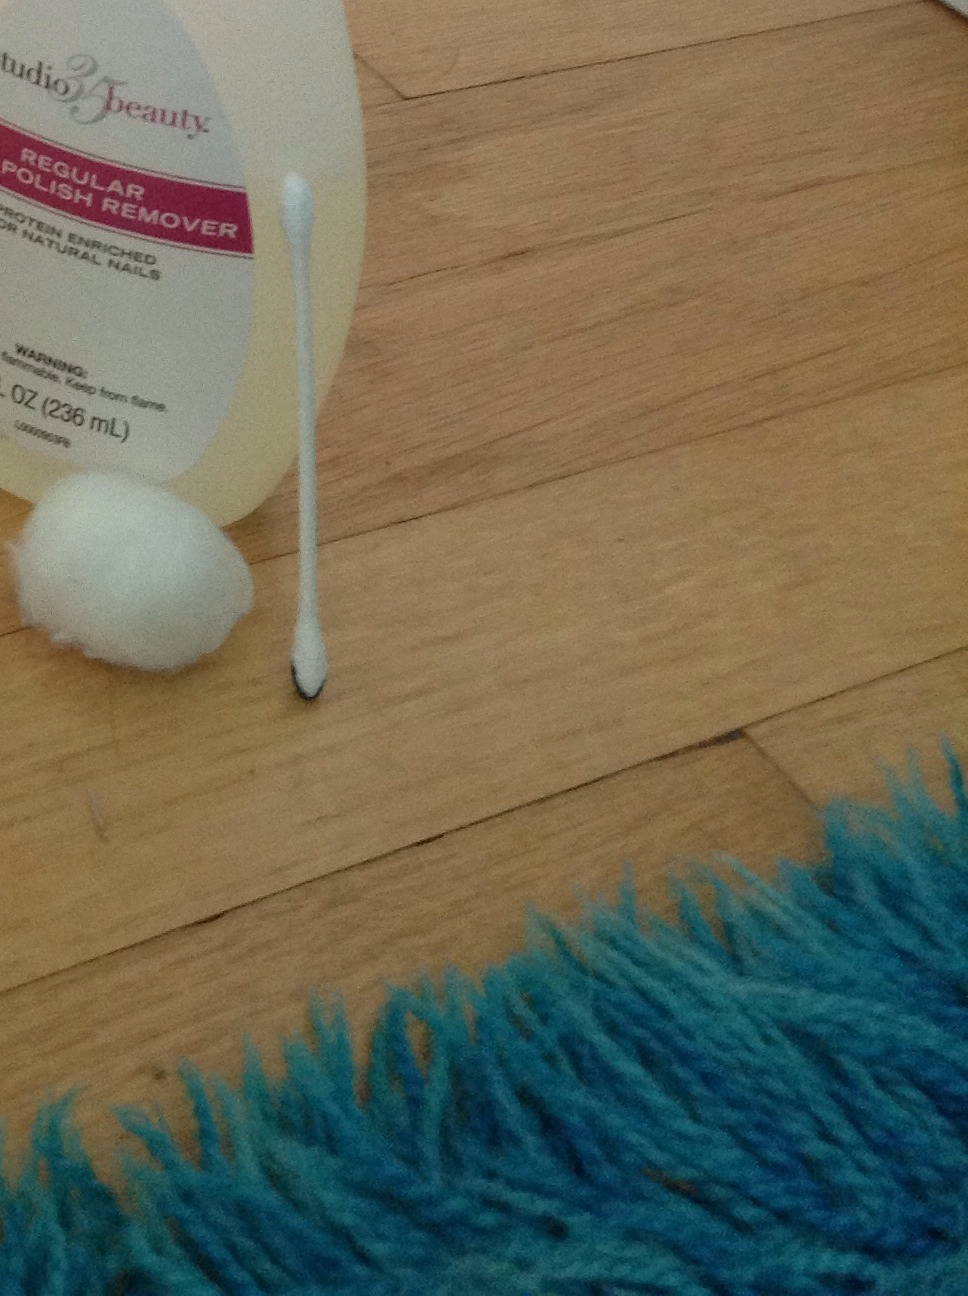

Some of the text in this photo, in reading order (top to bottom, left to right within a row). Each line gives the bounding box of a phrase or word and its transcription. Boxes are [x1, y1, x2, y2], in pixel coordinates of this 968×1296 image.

[104, 85, 211, 140] beauty
[1, 159, 94, 208] POLISH
[101, 196, 239, 240] REMOVER
[20, 147, 146, 201] REGULAR
[22, 228, 102, 266] NATURAL
[107, 257, 162, 282] NAILS
[67, 230, 158, 266] ENRICHED
[11, 384, 39, 411] OZ
[41, 396, 86, 427] (236
[90, 415, 131, 444] mL)
